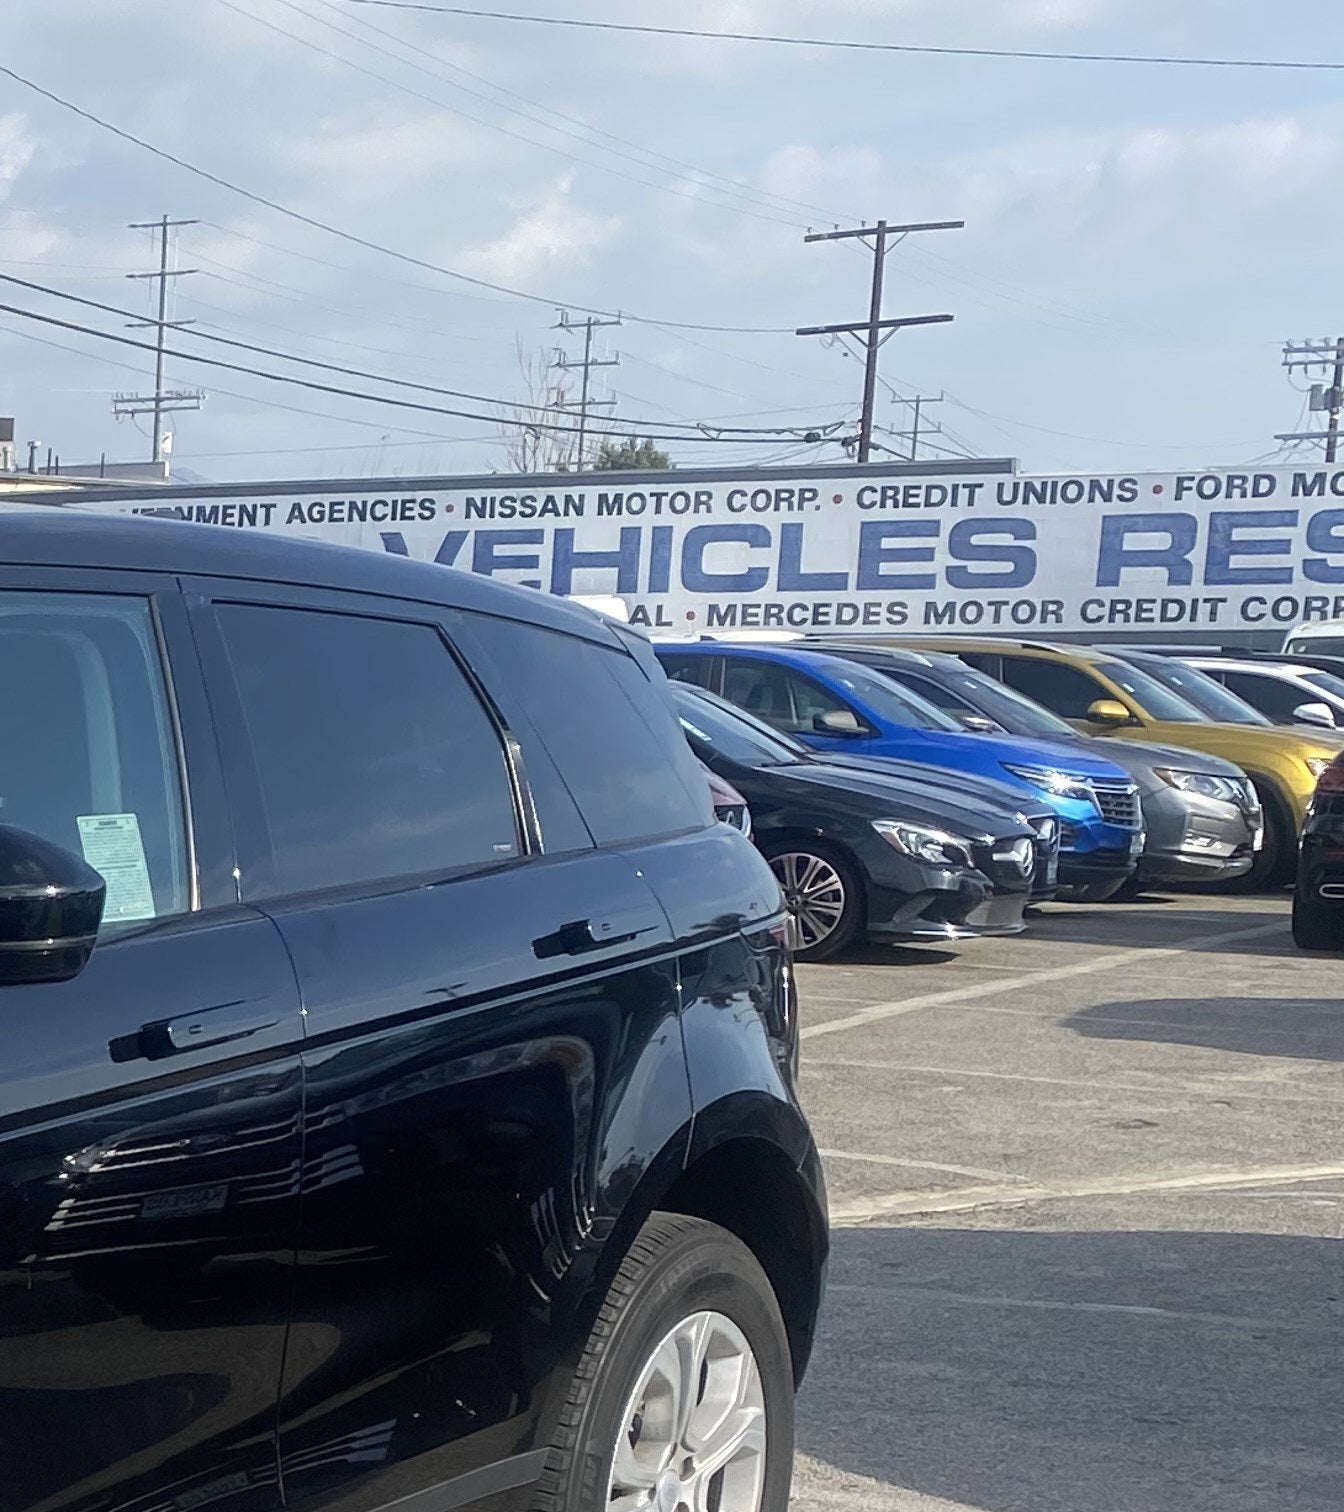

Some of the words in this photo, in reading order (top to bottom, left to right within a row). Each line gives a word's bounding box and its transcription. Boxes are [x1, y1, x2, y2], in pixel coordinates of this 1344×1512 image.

[285, 497, 436, 525] AGENCIES
[465, 493, 585, 520] NISSAN
[597, 490, 714, 516] MOTOR
[726, 487, 821, 513] CORP.
[856, 483, 984, 509] CREDIT
[996, 478, 1139, 506] UNIONS
[1174, 474, 1277, 501] FORD
[379, 518, 1037, 596] VEHICLES
[707, 600, 909, 627] MERCEDES
[923, 599, 1064, 625] MOTOR
[1080, 597, 1228, 624] CREDIT
